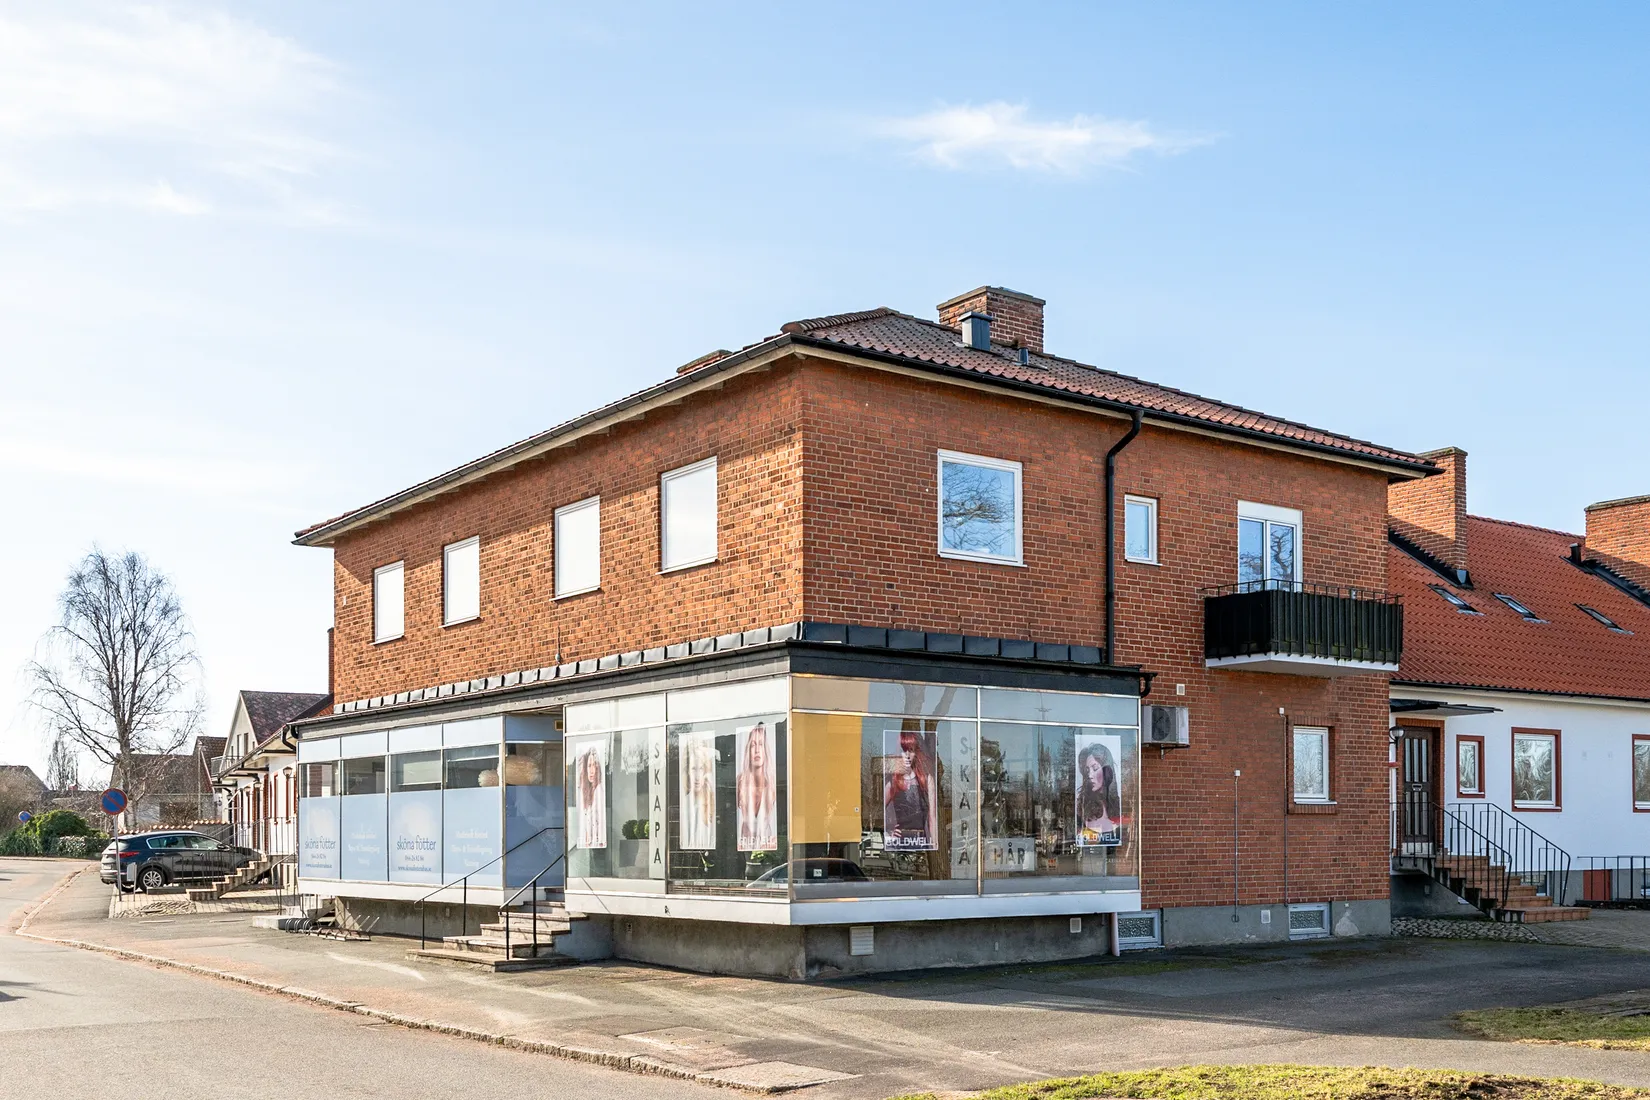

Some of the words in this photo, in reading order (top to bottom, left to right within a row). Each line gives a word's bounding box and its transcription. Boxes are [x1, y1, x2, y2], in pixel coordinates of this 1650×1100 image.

[653, 742, 662, 864] SKAPA
[958, 737, 971, 865] SKAPA
[396, 835, 415, 850] sköna
[415, 834, 437, 850] fötter
[885, 836, 936, 847] GOLDWELL
[1076, 833, 1119, 842] GOLDWELL
[993, 841, 1026, 865] HÅR
